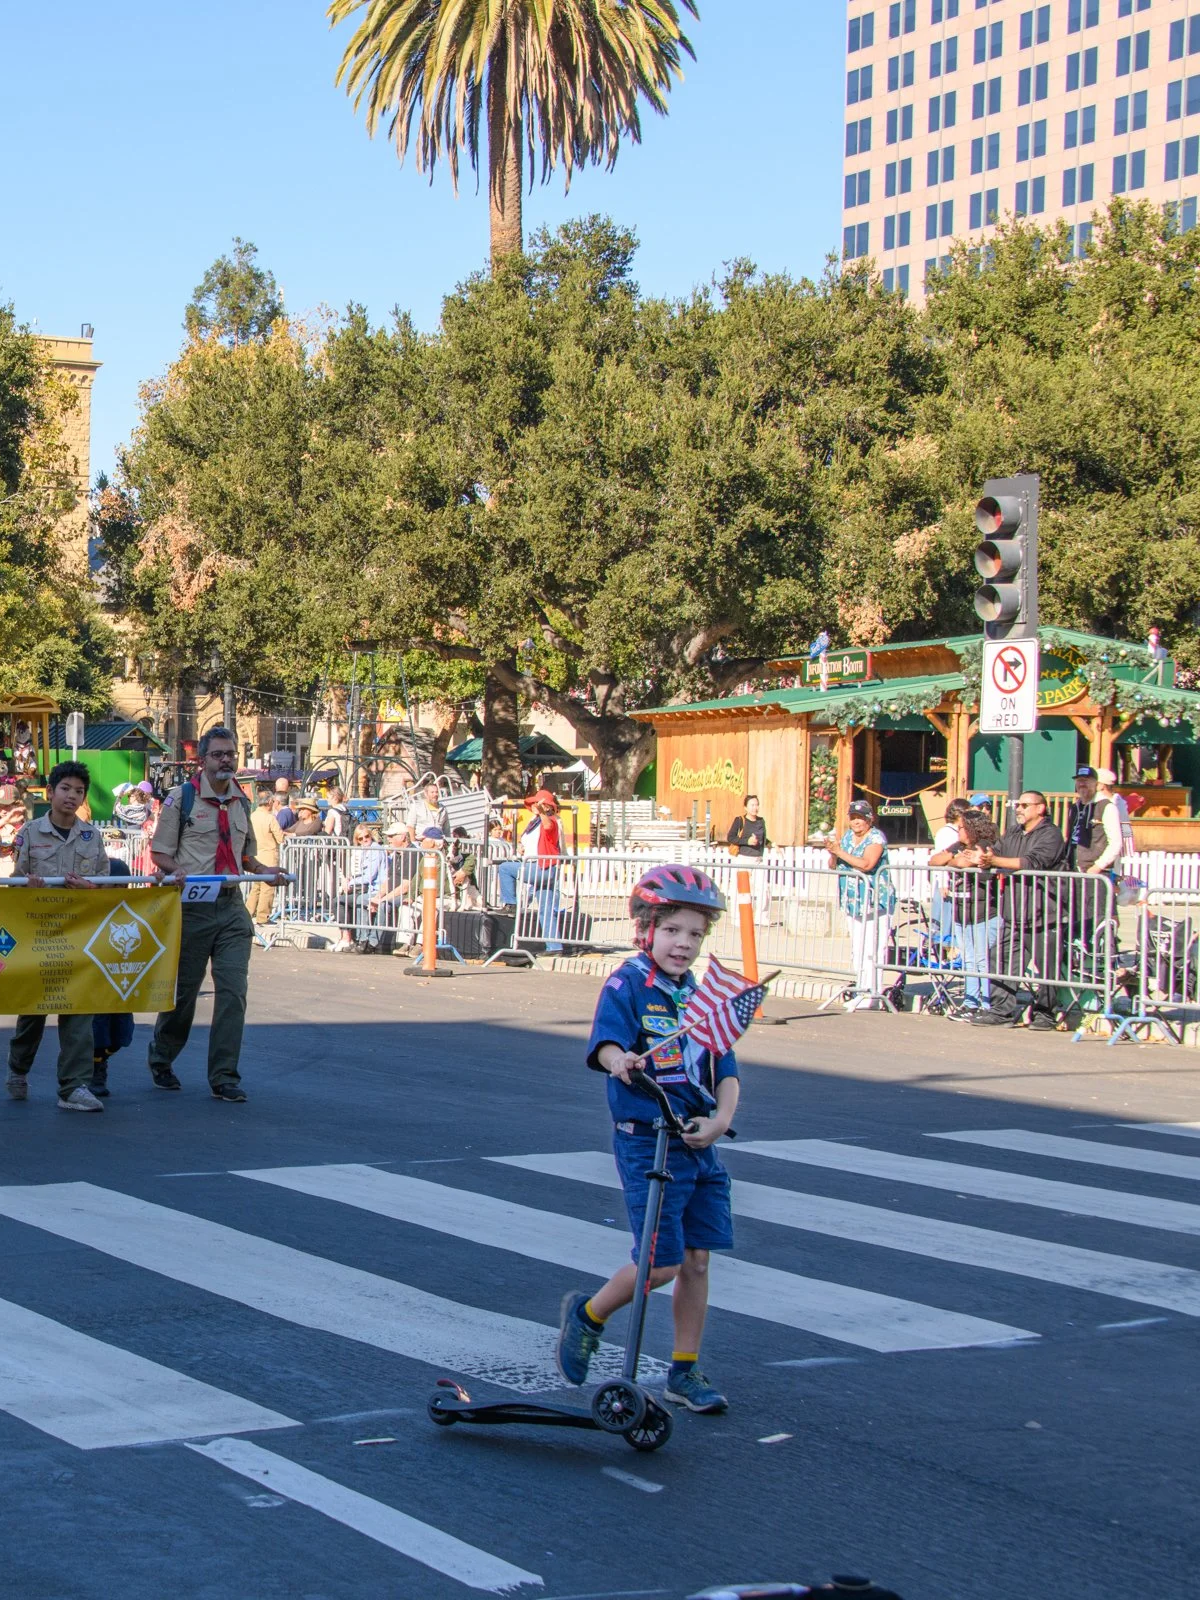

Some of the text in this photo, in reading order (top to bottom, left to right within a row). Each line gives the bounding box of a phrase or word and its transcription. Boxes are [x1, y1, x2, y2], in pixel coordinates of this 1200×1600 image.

[1044, 676, 1085, 705] PARK
[1000, 697, 1016, 710] ON
[994, 713, 1019, 727] RED
[881, 806, 909, 815] CLOSED
[188, 885, 211, 900] 67
[120, 961, 147, 974] SCOUTS
